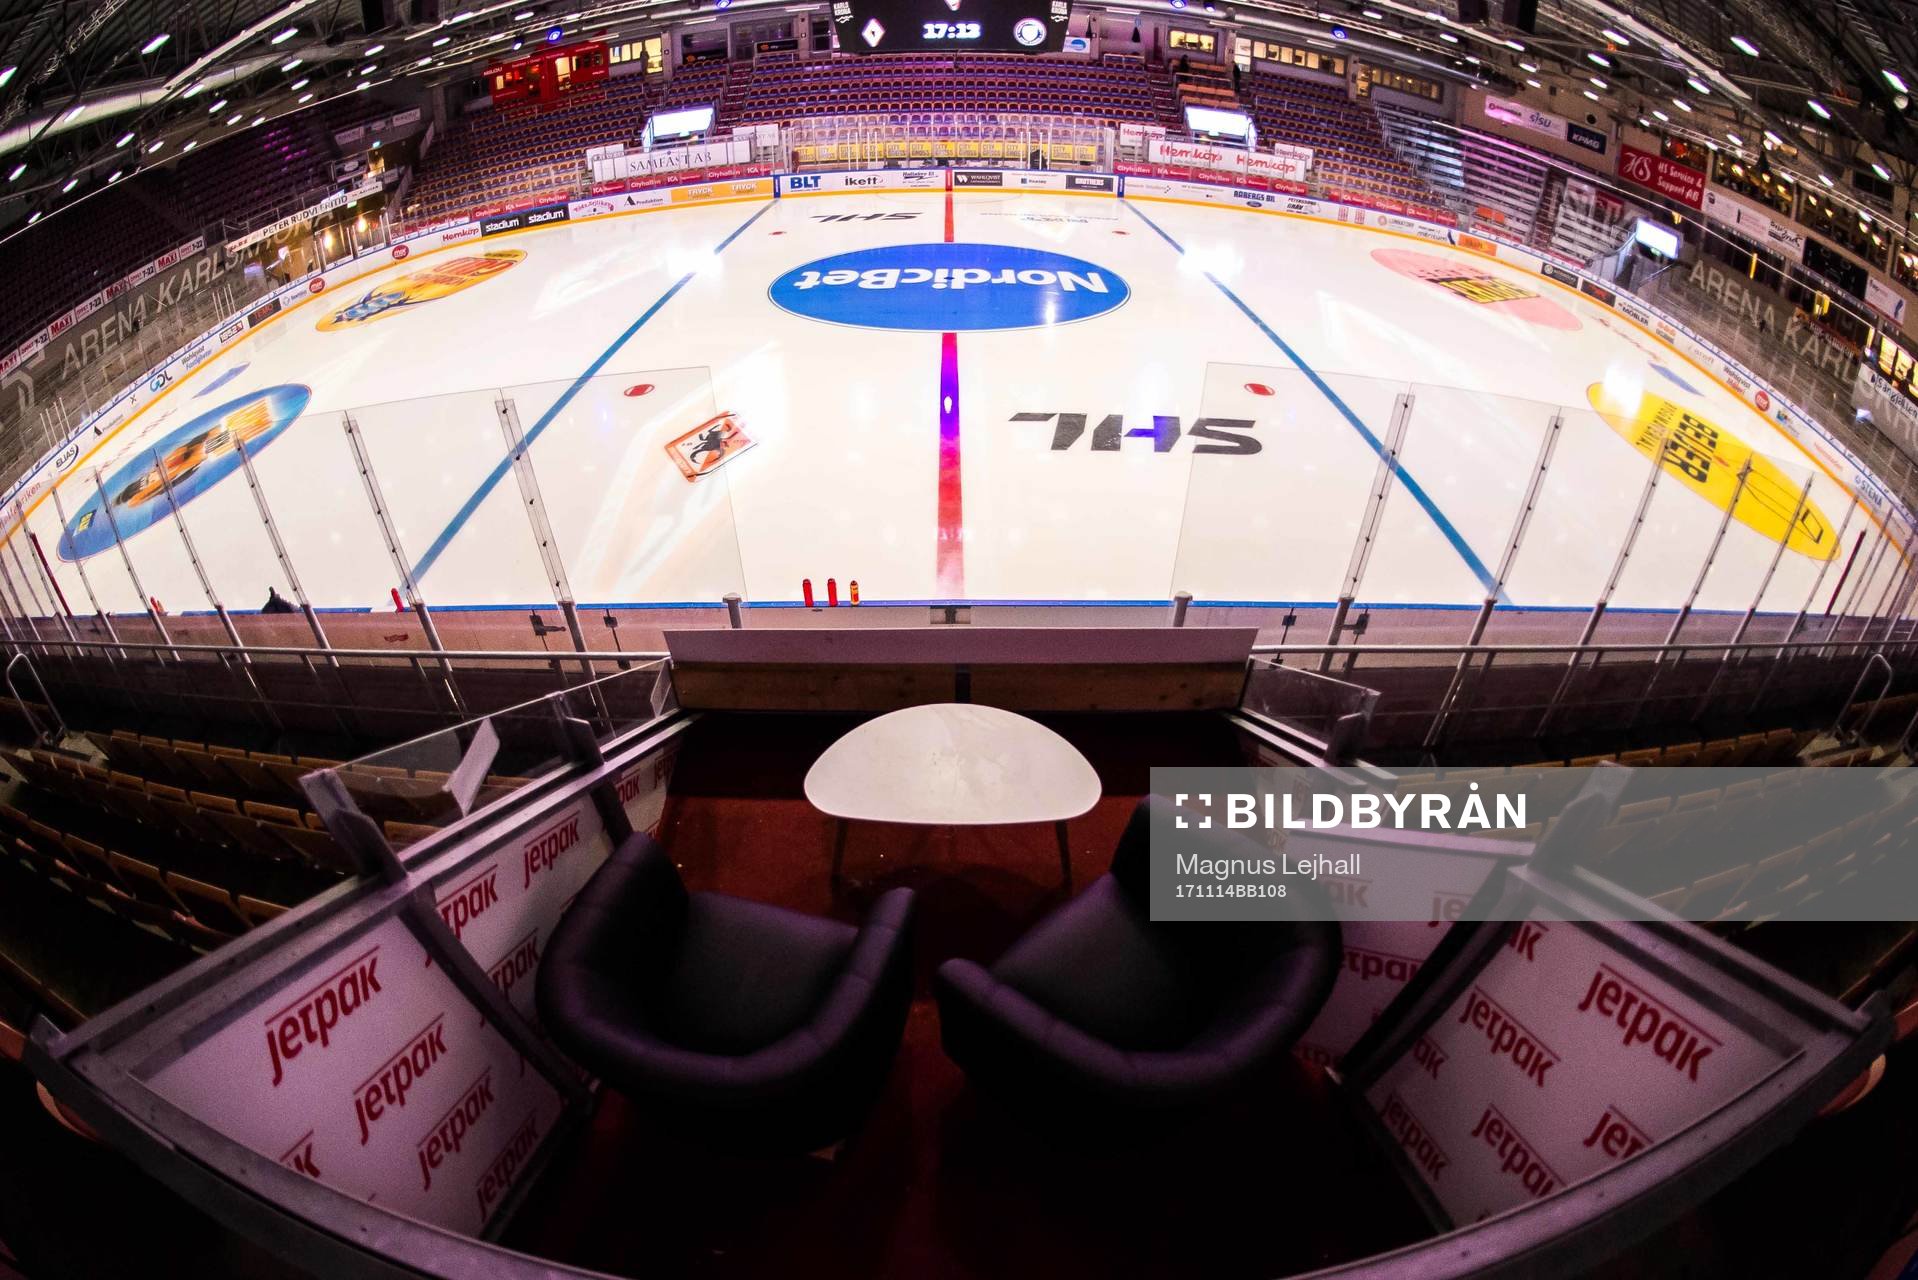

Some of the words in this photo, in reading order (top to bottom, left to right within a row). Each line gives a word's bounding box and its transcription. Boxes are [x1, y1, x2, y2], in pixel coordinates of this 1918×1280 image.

[1572, 133, 1600, 149] KPMG
[790, 176, 821, 189] BLT
[1657, 176, 1685, 197] Support
[1685, 190, 1700, 203] AB
[1669, 165, 1695, 184] Service
[263, 221, 290, 237] PETER
[319, 194, 348, 212] FRITID
[485, 218, 520, 233] stadium
[528, 209, 565, 225] stadium
[158, 251, 178, 269] MAXI
[795, 266, 1109, 295] NordicBet
[1689, 259, 1776, 335] ARENA
[50, 315, 73, 336] MAXI
[63, 294, 148, 380] ARENA
[1008, 412, 1263, 455] SHL
[1663, 413, 1719, 483] BEIJER
[56, 446, 76, 468] ELIAS
[1860, 479, 1883, 506] STENA
[524, 815, 580, 889] jetpak
[266, 955, 382, 1087] jetpak
[1458, 991, 1554, 1088] jetpak
[1578, 968, 1714, 1083] jetpak
[353, 1022, 447, 1145] jetpak
[417, 1074, 495, 1191] jetpak
[1380, 1095, 1449, 1182] jetpak
